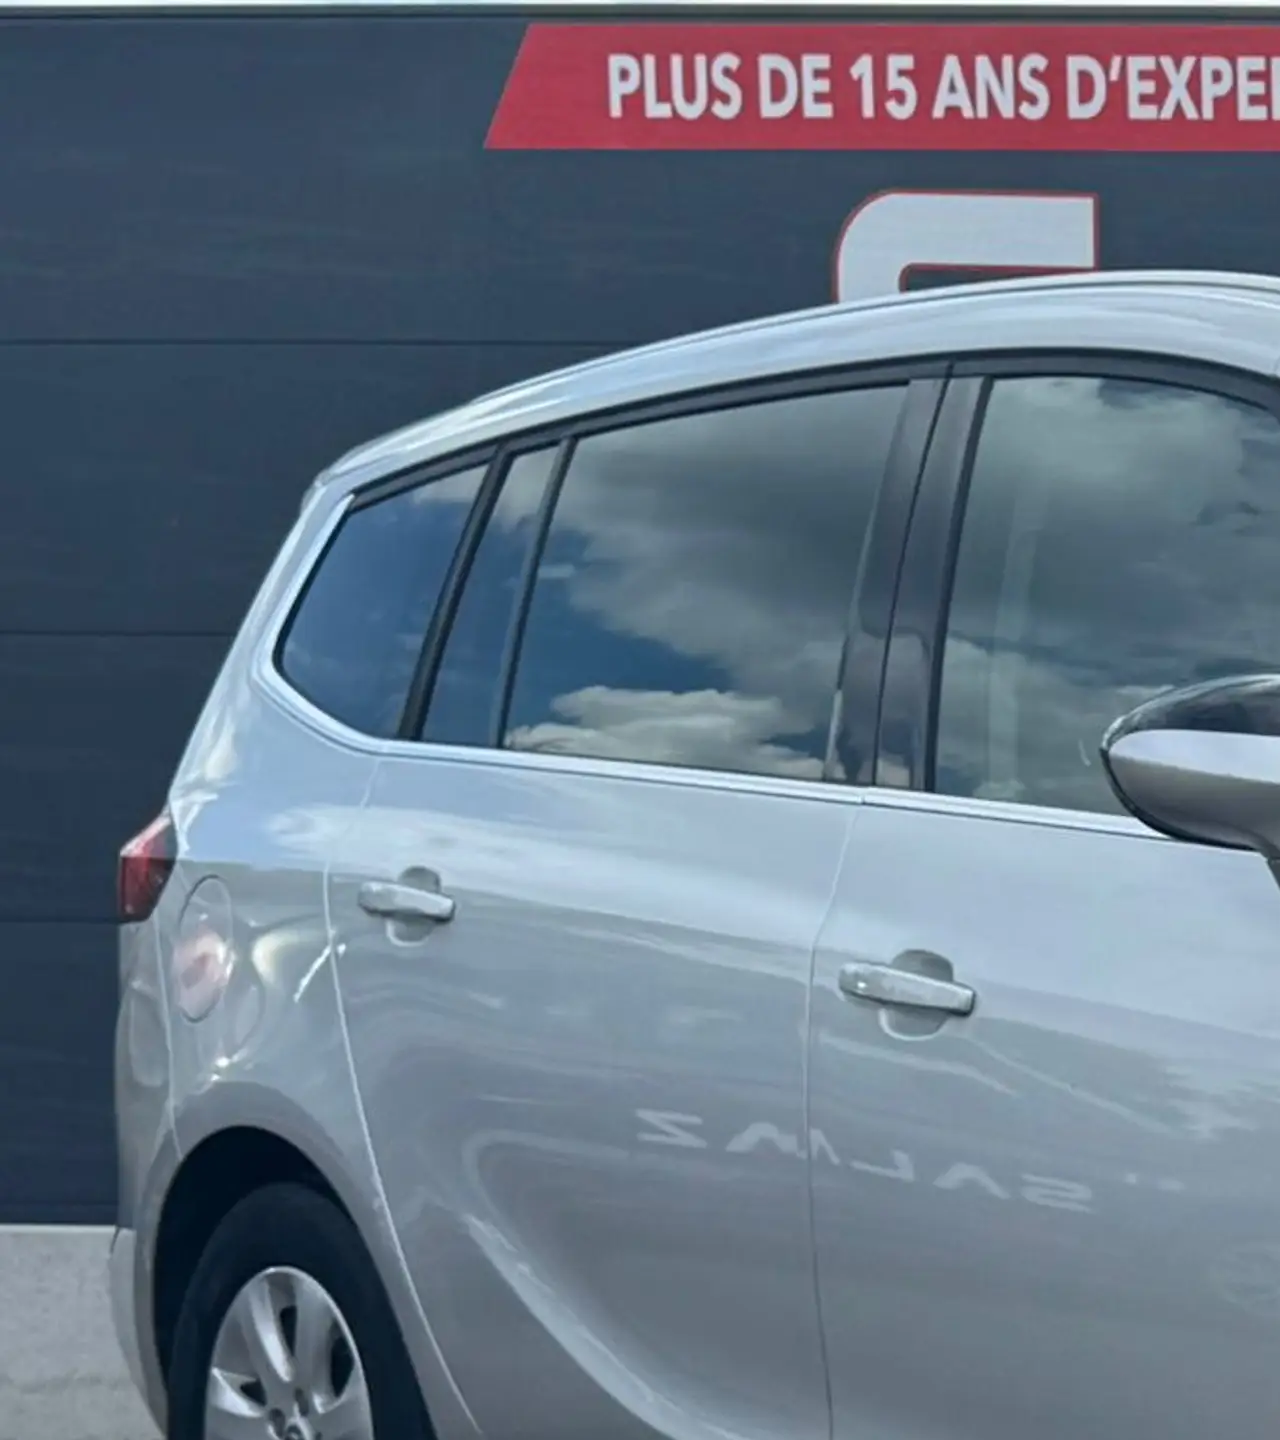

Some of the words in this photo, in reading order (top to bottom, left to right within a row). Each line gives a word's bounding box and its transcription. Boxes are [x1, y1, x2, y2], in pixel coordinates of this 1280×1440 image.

[608, 53, 742, 119] PLUS
[758, 54, 834, 118] DE
[850, 54, 918, 119] 15
[932, 53, 1050, 119] ANS
